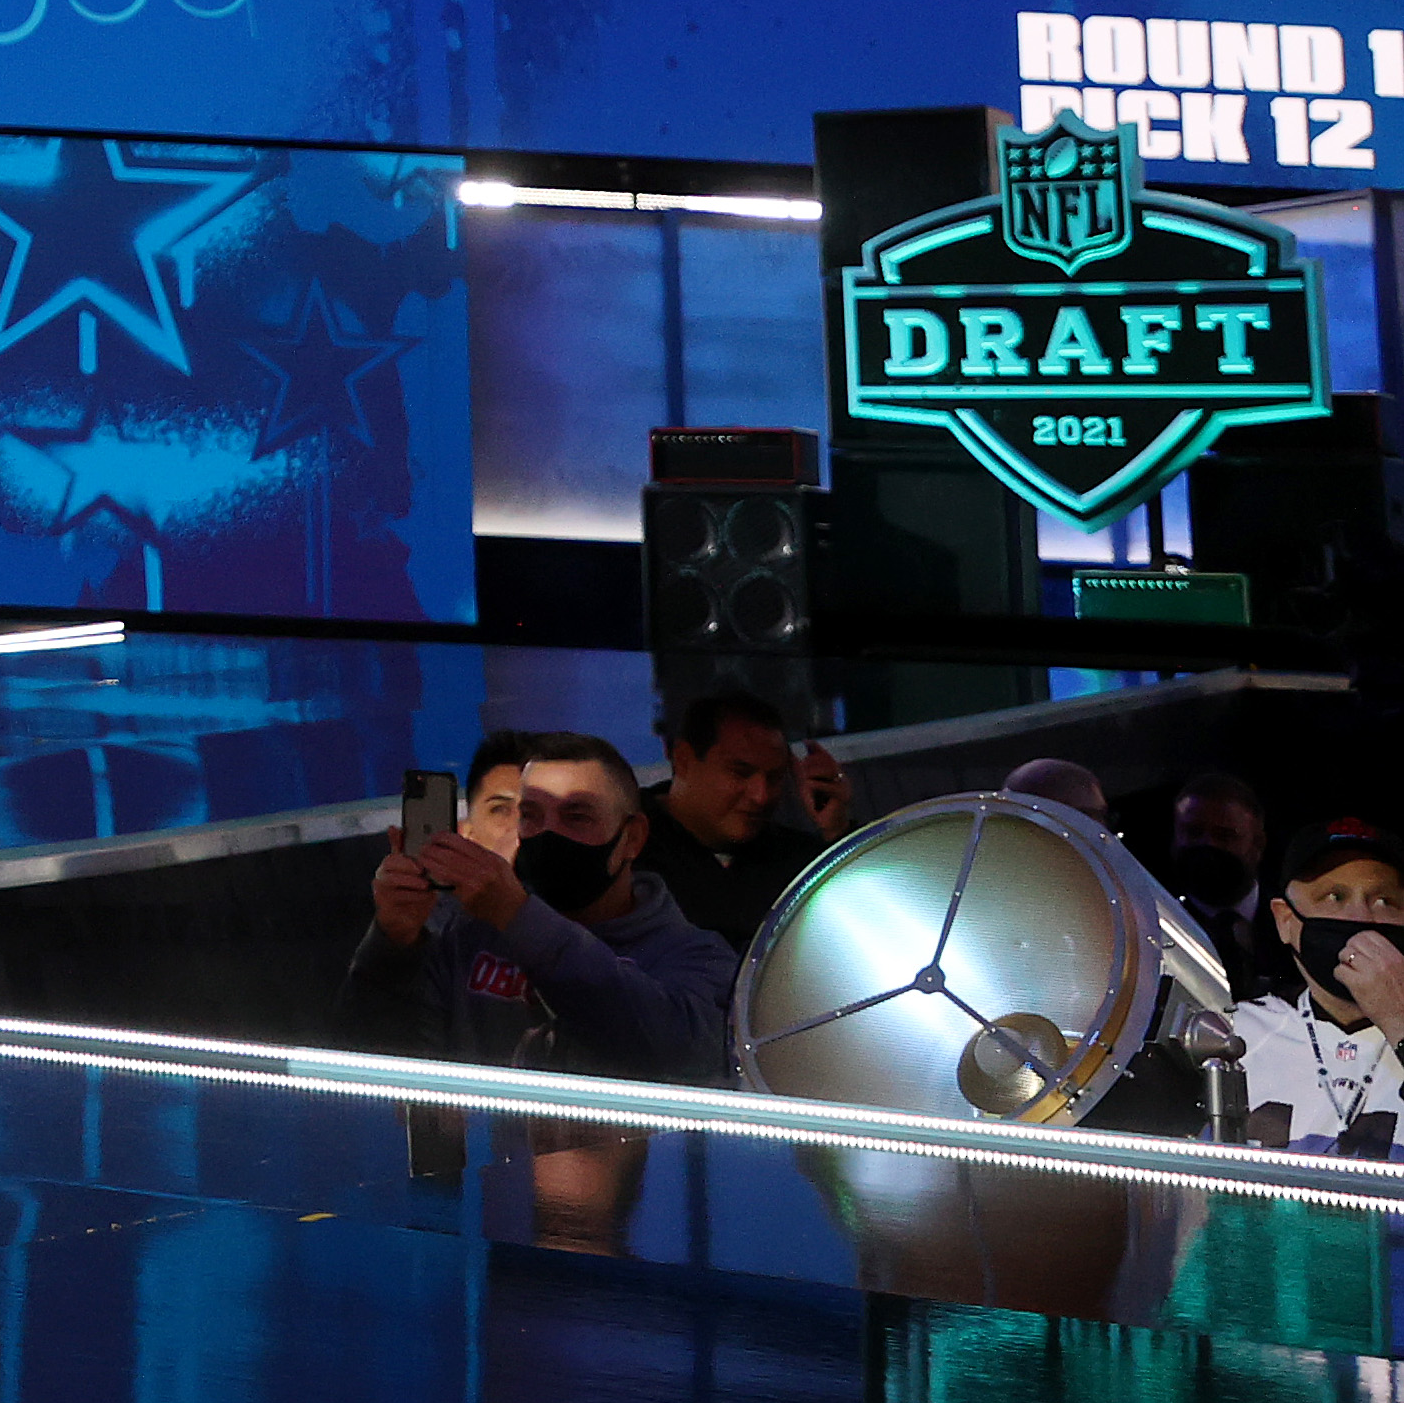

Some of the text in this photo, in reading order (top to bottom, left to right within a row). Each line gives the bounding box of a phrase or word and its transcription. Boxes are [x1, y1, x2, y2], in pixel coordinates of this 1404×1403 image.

[1017, 12, 1404, 98] ROUND 1
[1270, 96, 1376, 169] 12
[1012, 182, 1117, 246] NFL
[883, 304, 1271, 377] DRAFT
[1032, 414, 1126, 447] 2021
